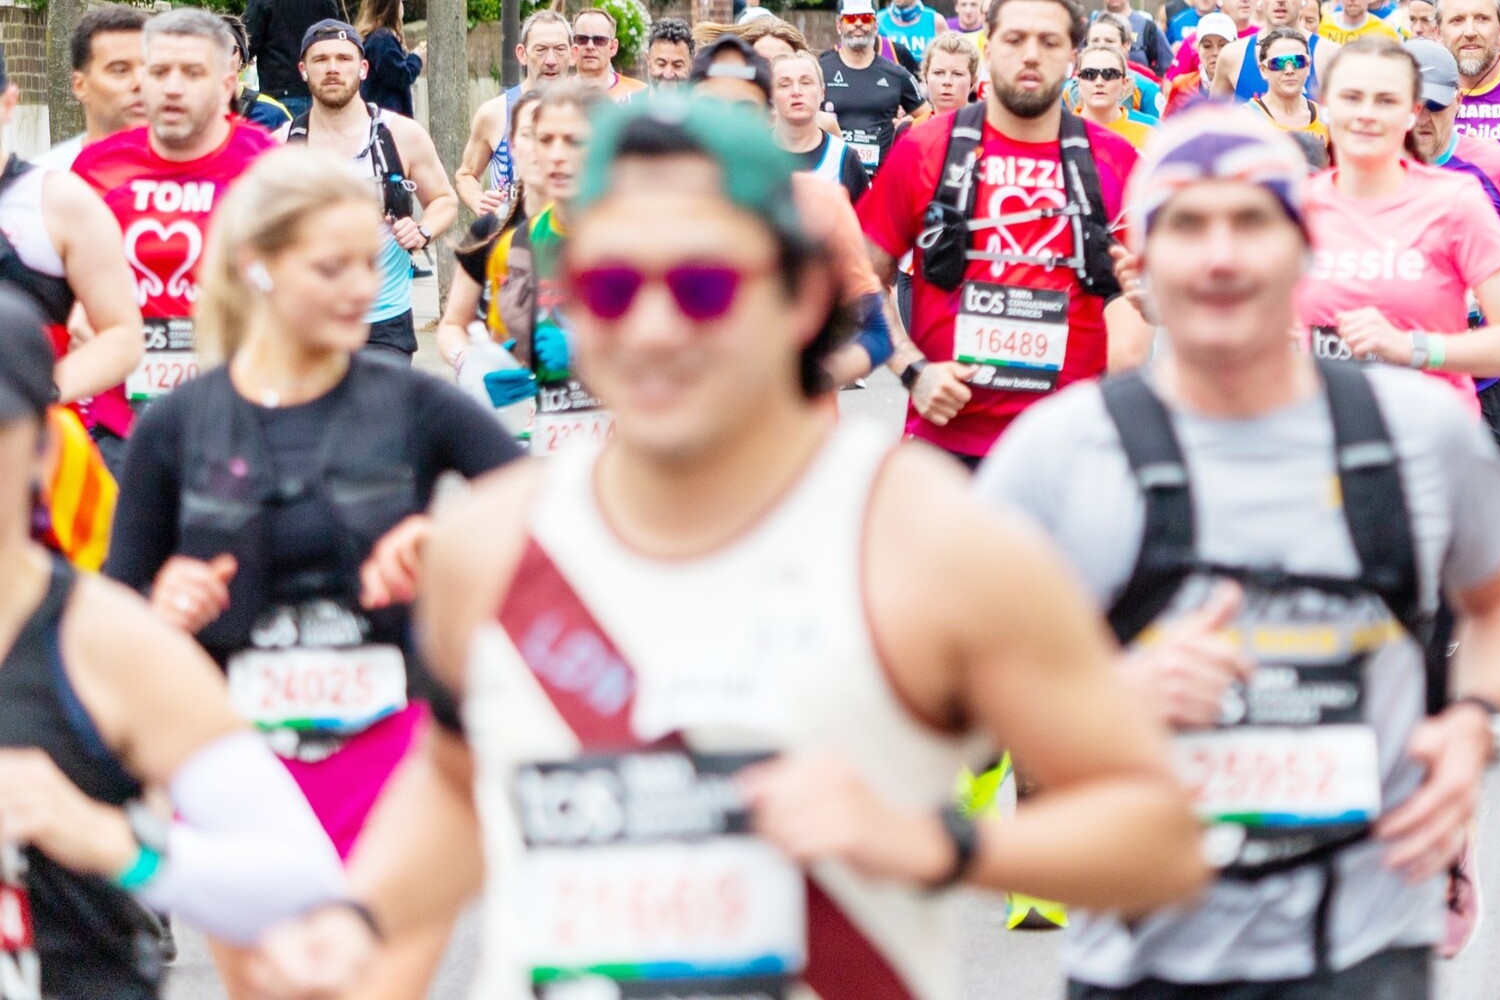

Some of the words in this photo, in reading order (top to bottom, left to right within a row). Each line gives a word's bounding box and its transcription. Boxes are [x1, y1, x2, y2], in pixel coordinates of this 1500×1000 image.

[130, 179, 216, 213] TOM
[1311, 238, 1426, 282] essie
[964, 283, 1006, 315] tcs
[143, 327, 167, 349] cs
[975, 327, 1049, 359] 16489
[1313, 327, 1353, 361] tcs
